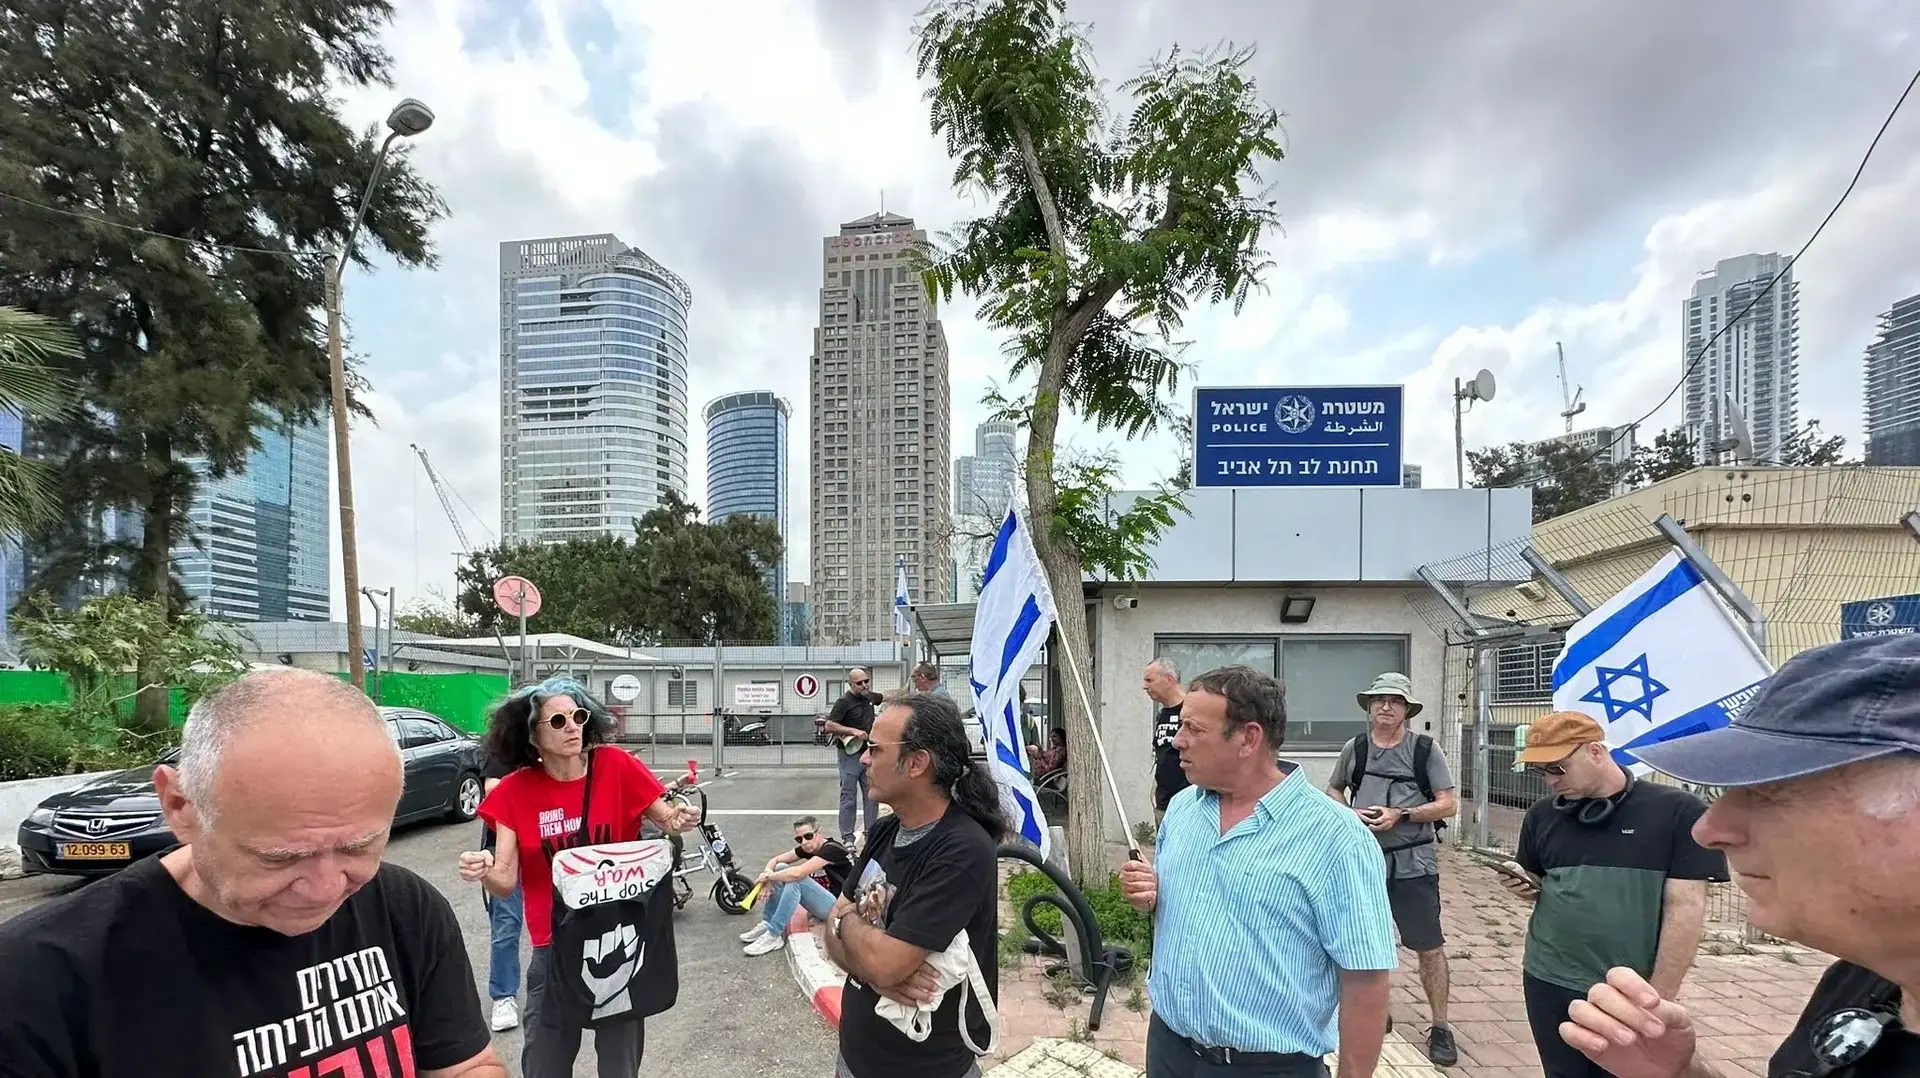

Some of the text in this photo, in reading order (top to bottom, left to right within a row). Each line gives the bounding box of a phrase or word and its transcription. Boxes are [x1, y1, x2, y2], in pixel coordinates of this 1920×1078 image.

[1210, 400, 1385, 416] משטרת ישראל
[1211, 423, 1267, 433] POLICE
[1323, 420, 1383, 435] الشرطة
[1217, 458, 1378, 475] תחנת לב תל אביב
[539, 808, 564, 824] BRING
[540, 816, 582, 838] THEM HOM
[233, 1006, 334, 1077] הביתה
